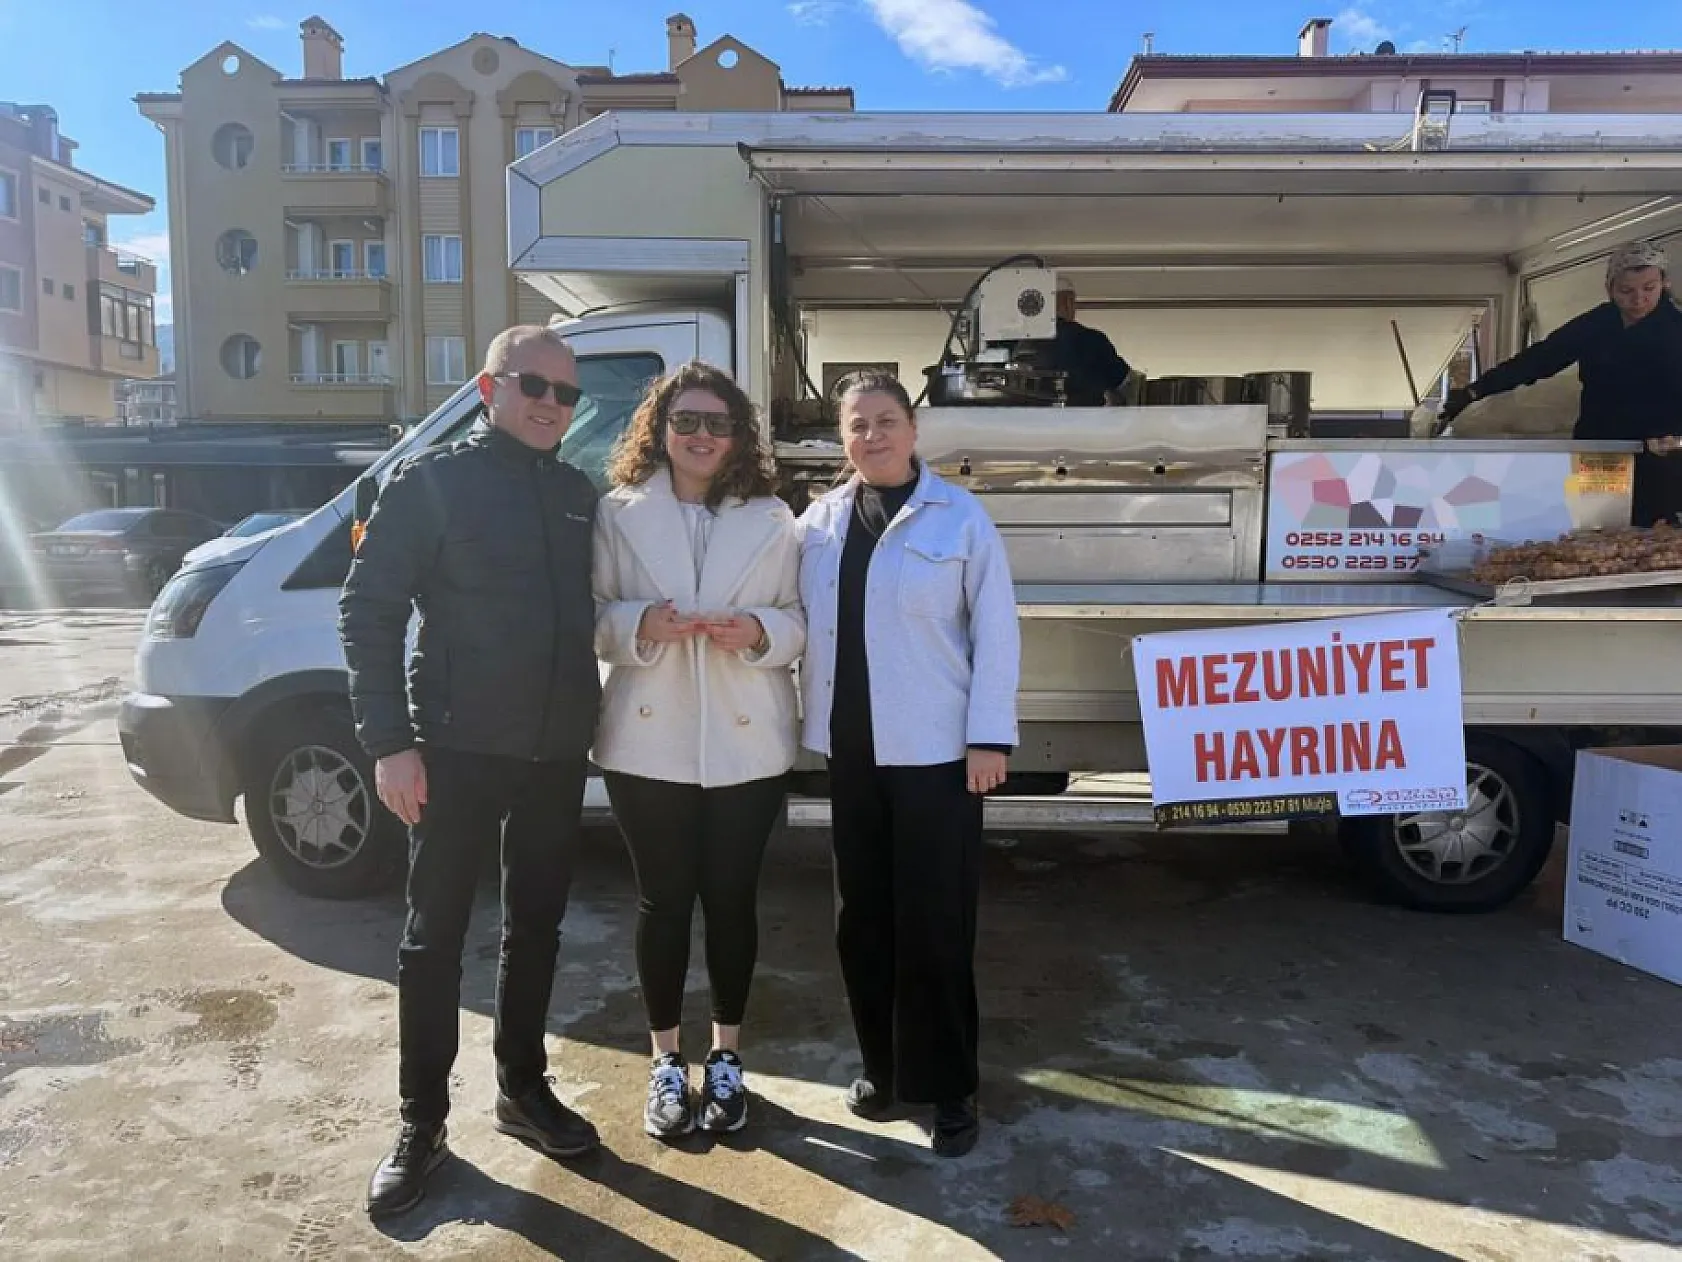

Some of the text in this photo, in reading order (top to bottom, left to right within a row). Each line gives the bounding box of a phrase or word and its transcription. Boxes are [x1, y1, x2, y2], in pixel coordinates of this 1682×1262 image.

[1286, 532, 1446, 546] 0252 214 16 94
[1282, 555, 1419, 569] 0530 223 57
[1156, 632, 1435, 708] MEZUNİYET
[1194, 718, 1406, 782] HAYRINA
